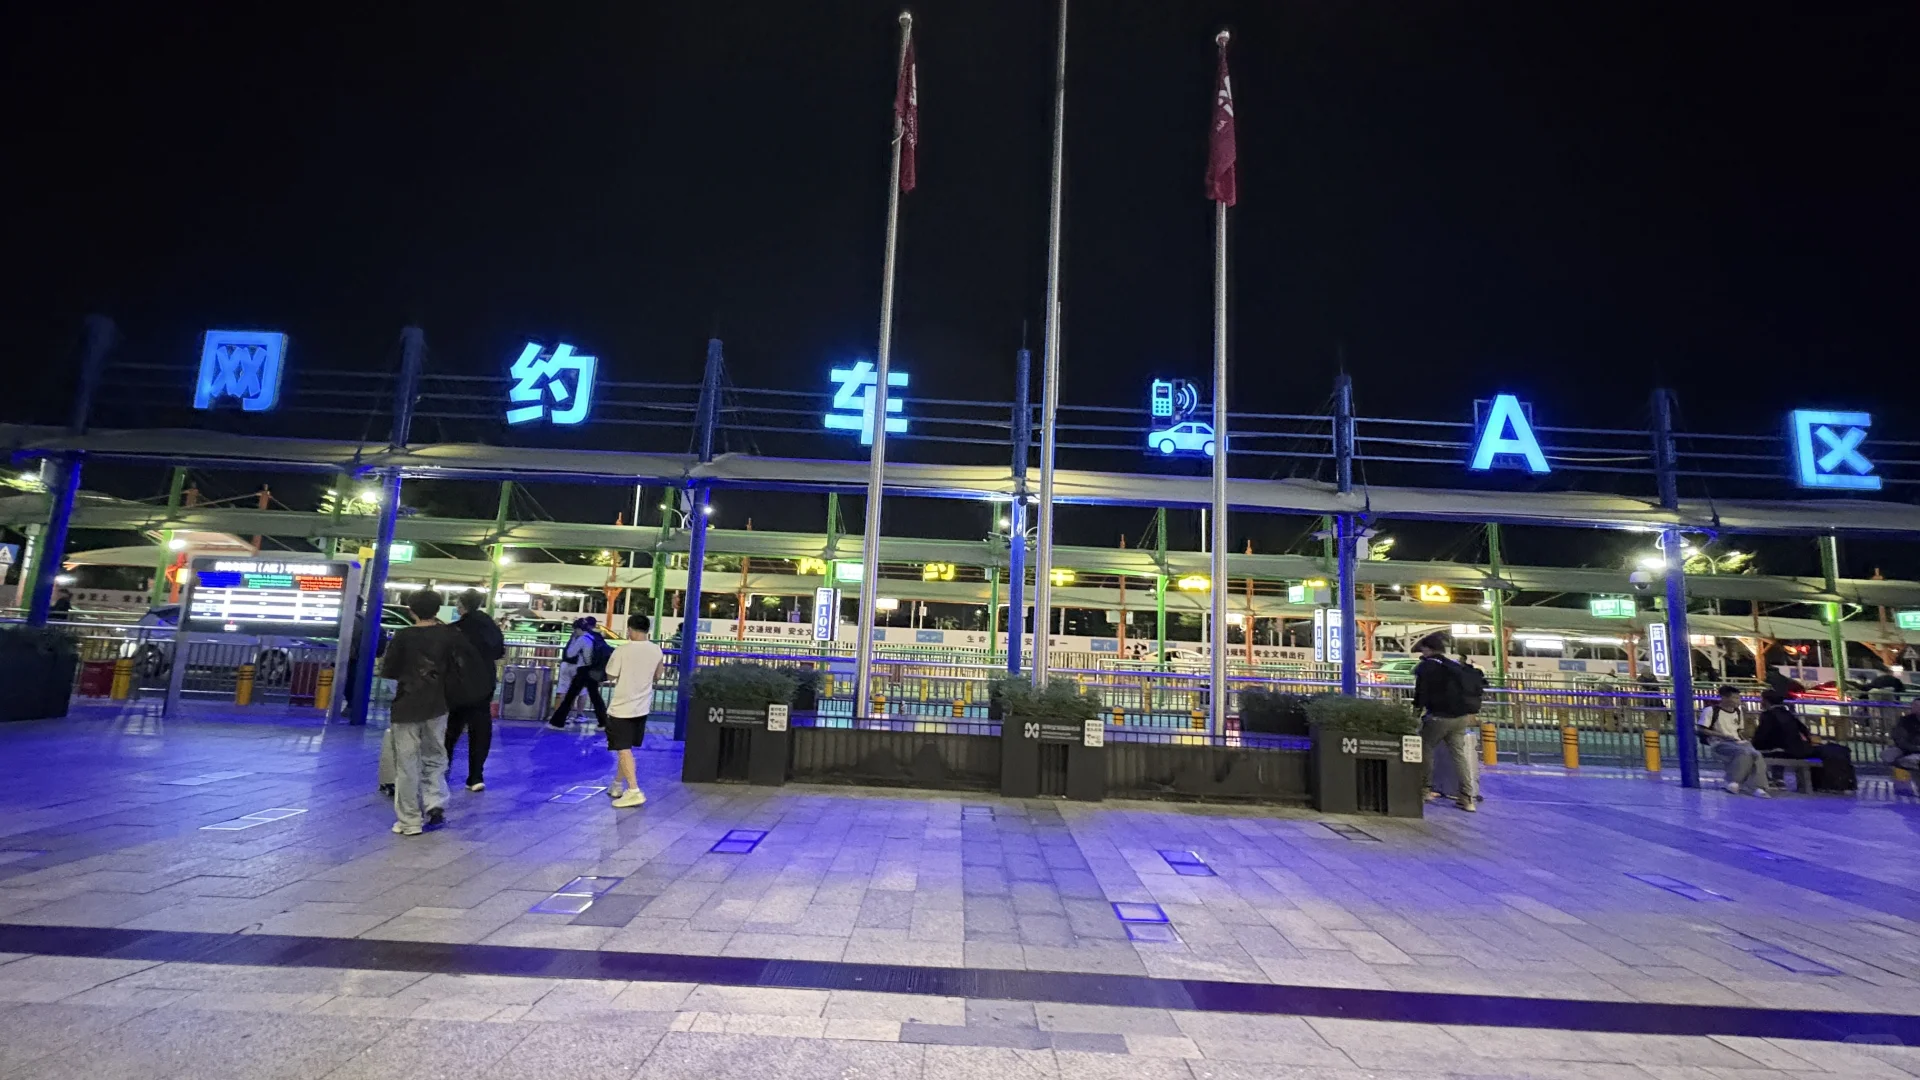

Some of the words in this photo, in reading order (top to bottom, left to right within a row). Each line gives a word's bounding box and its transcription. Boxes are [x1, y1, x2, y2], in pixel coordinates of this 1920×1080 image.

[193, 330, 288, 412] 网
[506, 341, 597, 426] 约
[824, 361, 909, 445] 车
[1471, 394, 1551, 473] A
[1790, 409, 1883, 490] 区
[818, 606, 828, 637] 102
[967, 635, 1009, 645] 生命上
[1025, 638, 1068, 647] 安第一
[1330, 628, 1341, 660] 103
[1655, 642, 1665, 673] 104
